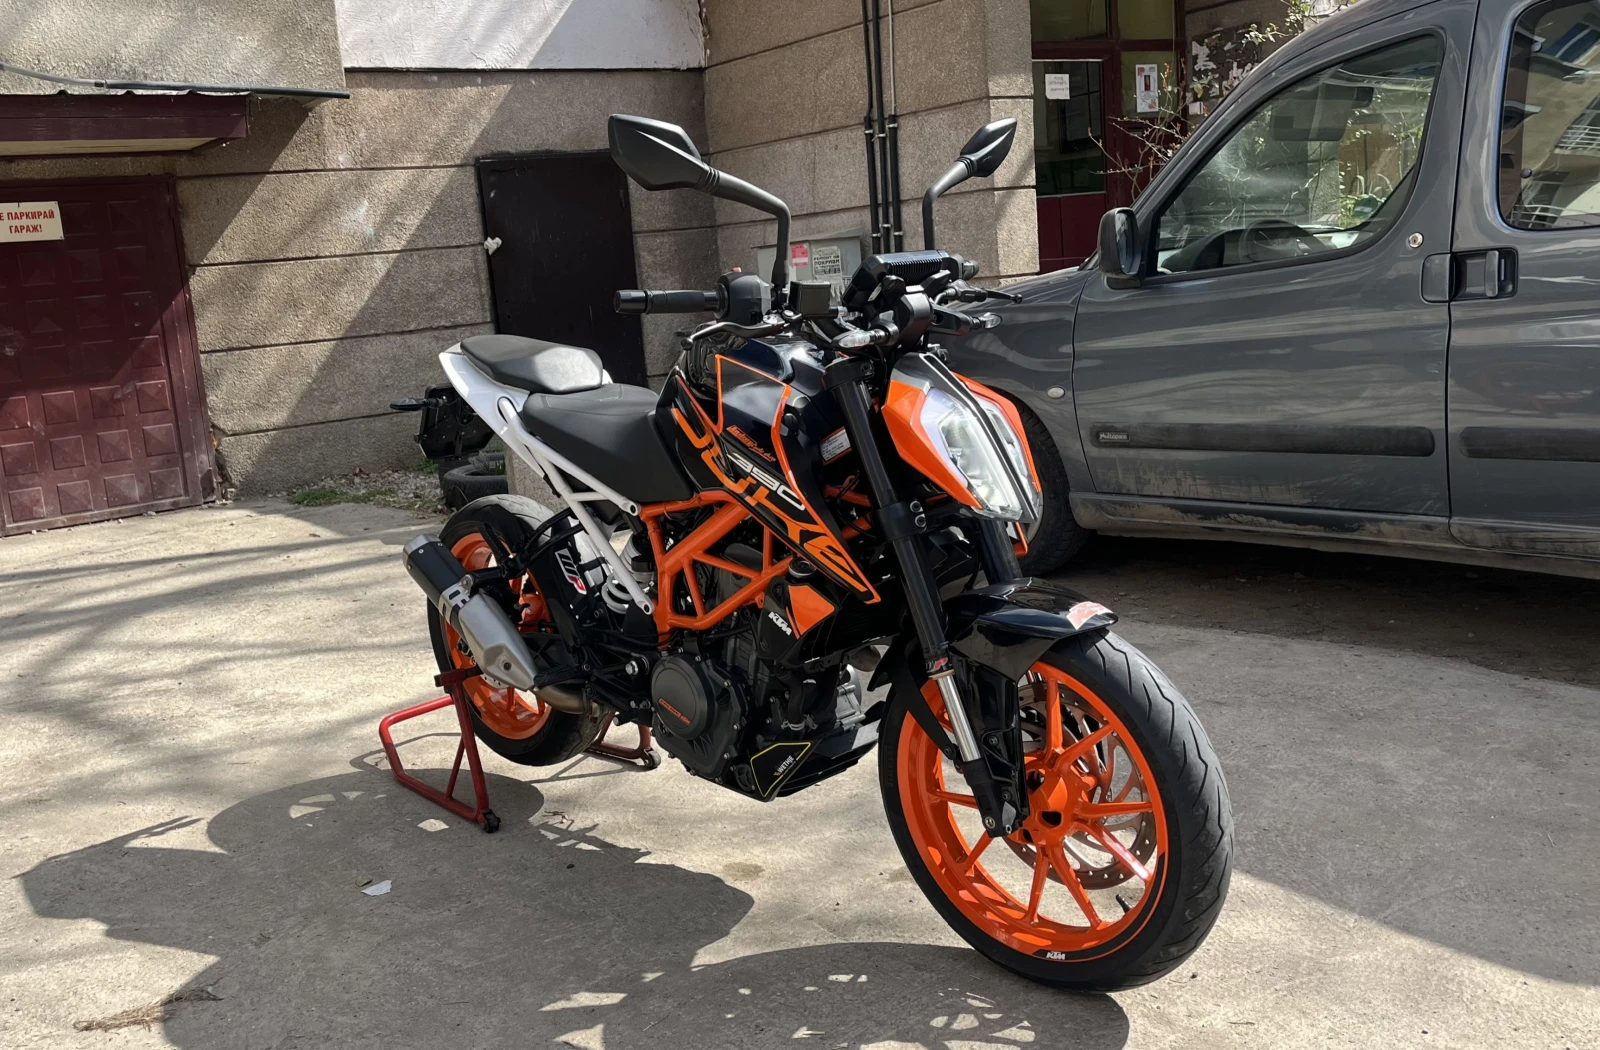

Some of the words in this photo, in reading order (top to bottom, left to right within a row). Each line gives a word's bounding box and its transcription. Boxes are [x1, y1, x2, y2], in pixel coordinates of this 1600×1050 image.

[7, 209, 55, 220] ПАРКИРАЙ
[9, 224, 42, 234] ГАРАЖ!
[727, 452, 806, 511] 390
[769, 611, 793, 636] KTM
[1046, 951, 1066, 960] KTM
